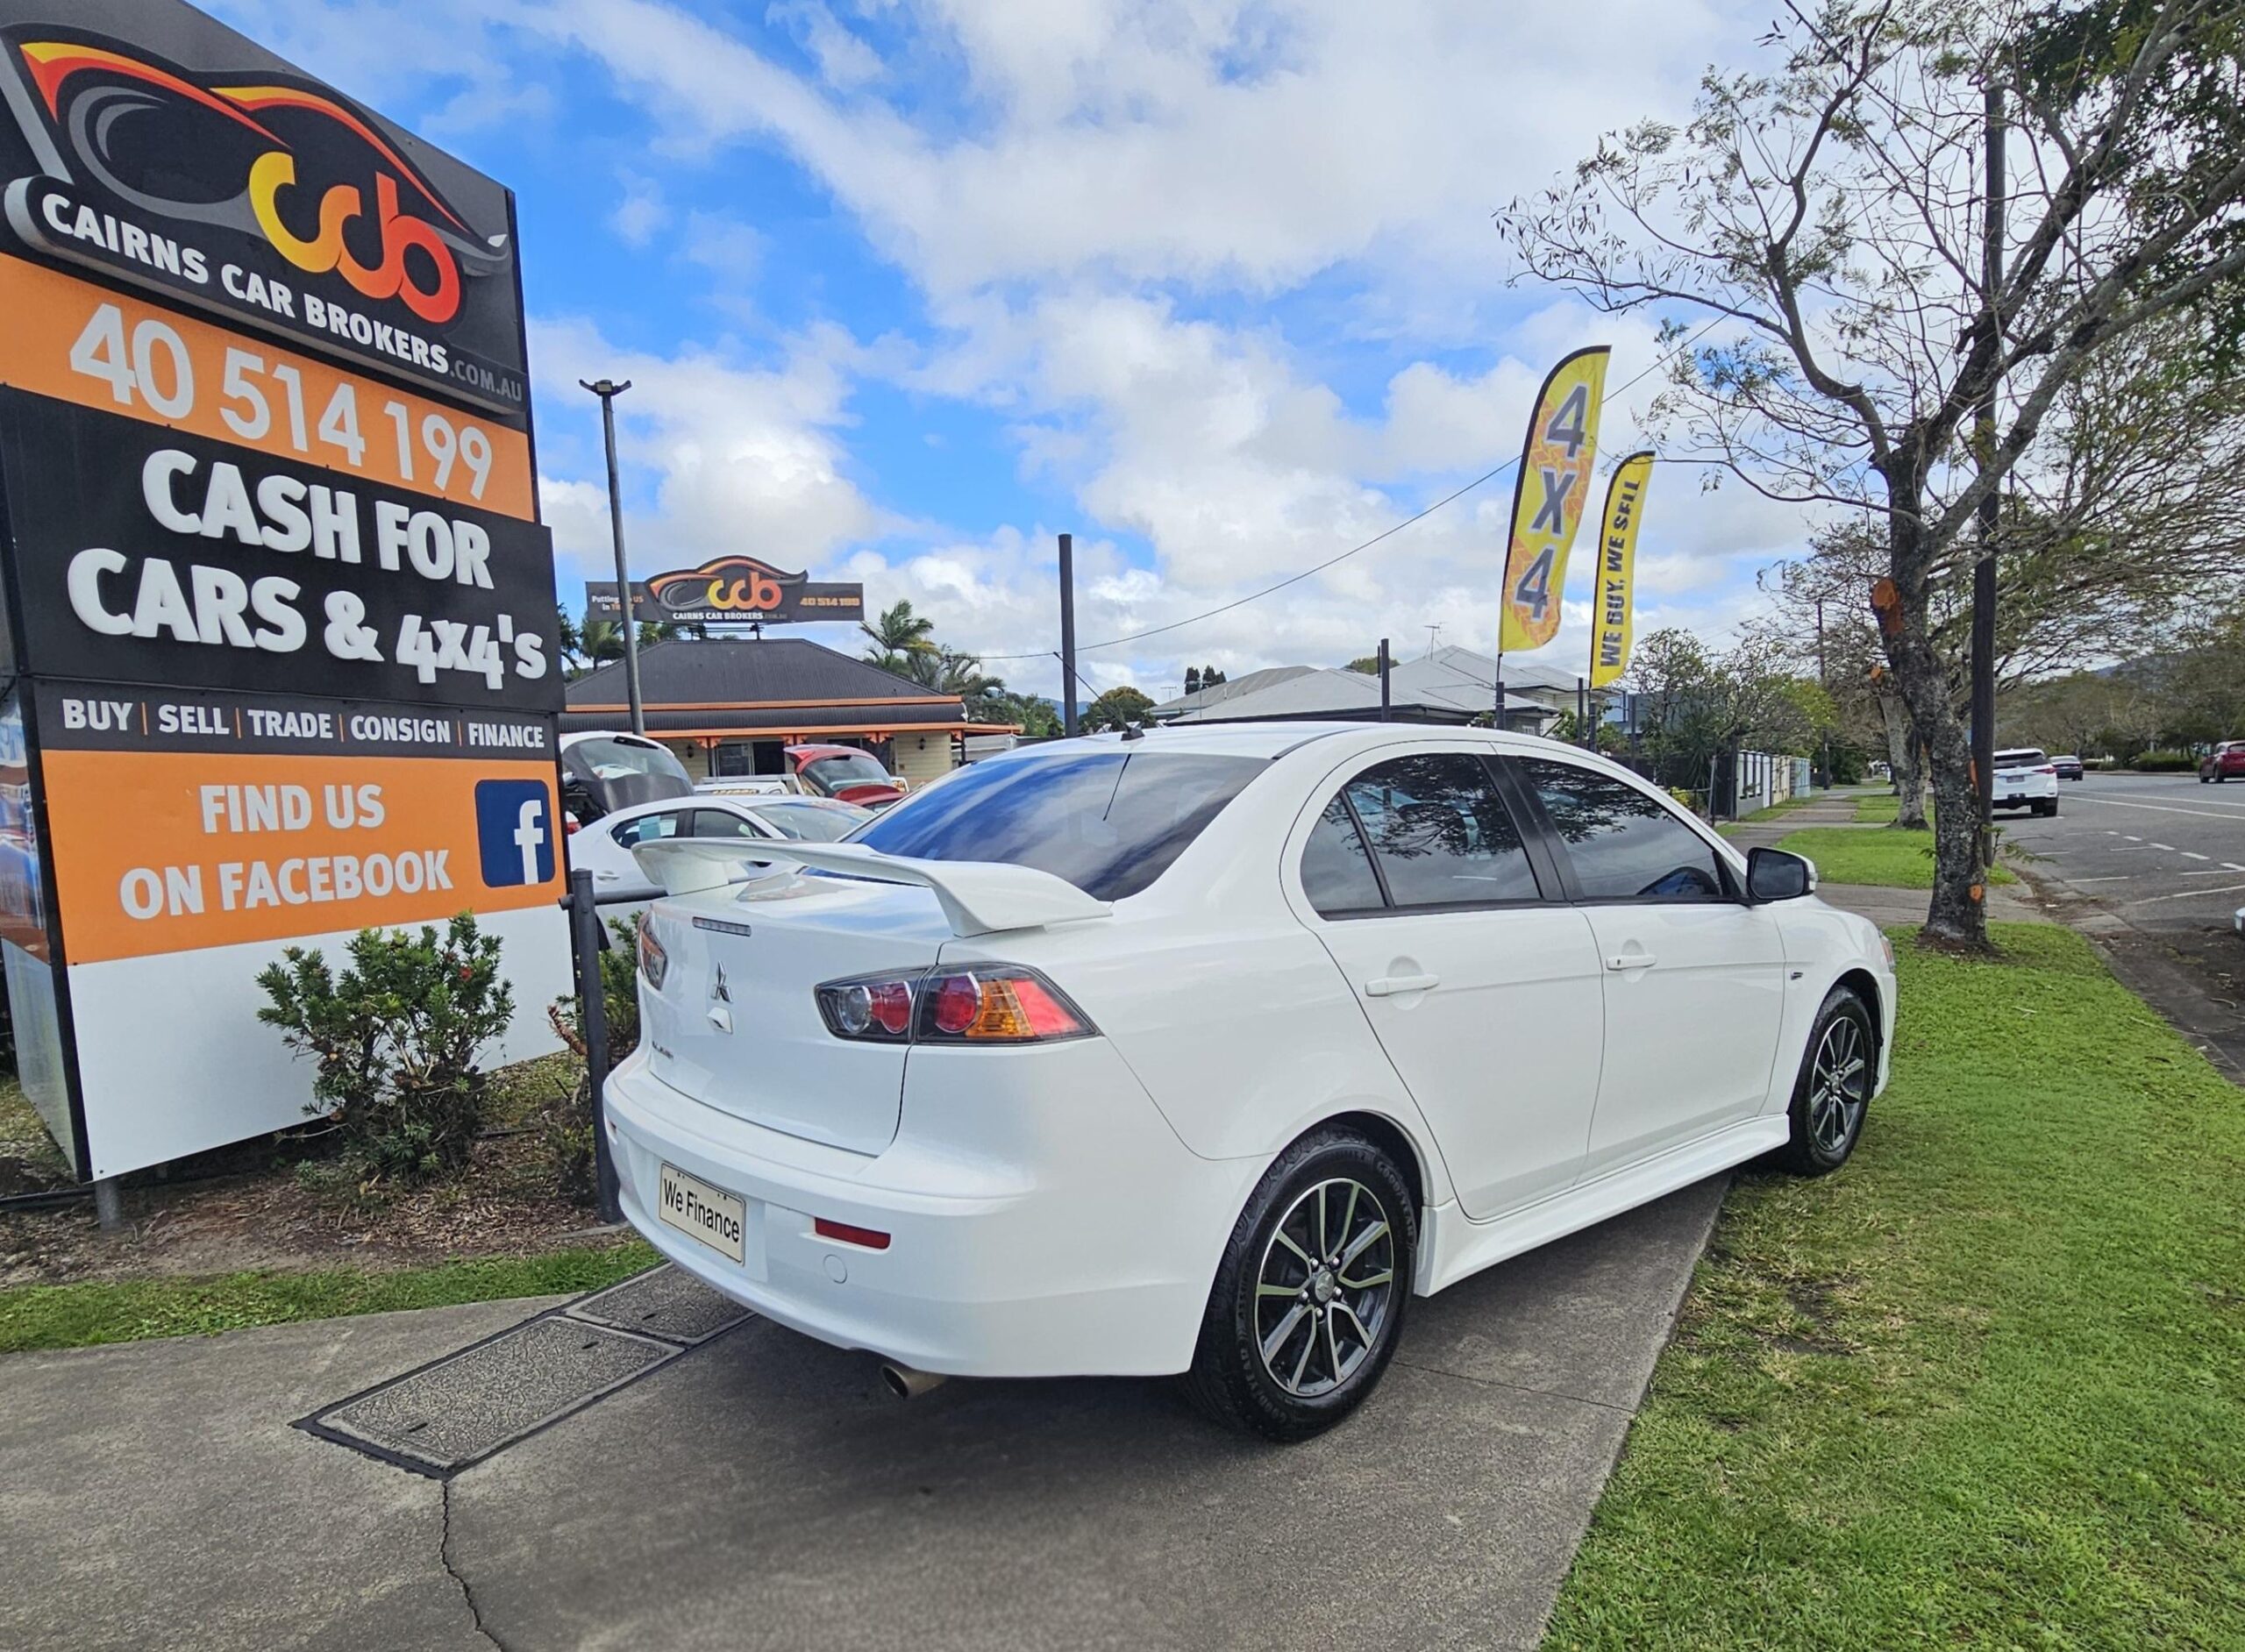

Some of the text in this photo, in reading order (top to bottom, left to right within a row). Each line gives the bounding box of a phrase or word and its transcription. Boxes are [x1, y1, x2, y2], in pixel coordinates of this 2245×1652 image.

[42, 194, 209, 284] CAIRNS
[222, 265, 296, 318] CAR
[70, 303, 493, 501] 40 514 199
[143, 450, 494, 588] CASH FOR
[1613, 480, 1641, 531] SELL
[1606, 535, 1625, 573] WE
[68, 548, 306, 652] CARS
[324, 590, 384, 661] &
[1600, 630, 1622, 667] WE
[62, 698, 545, 748] BUY SELL TRADE CONSIGN FINANCE
[199, 784, 386, 834] FIND US
[119, 849, 453, 919] ON FACEBOOK
[664, 1178, 740, 1243] We Finance
